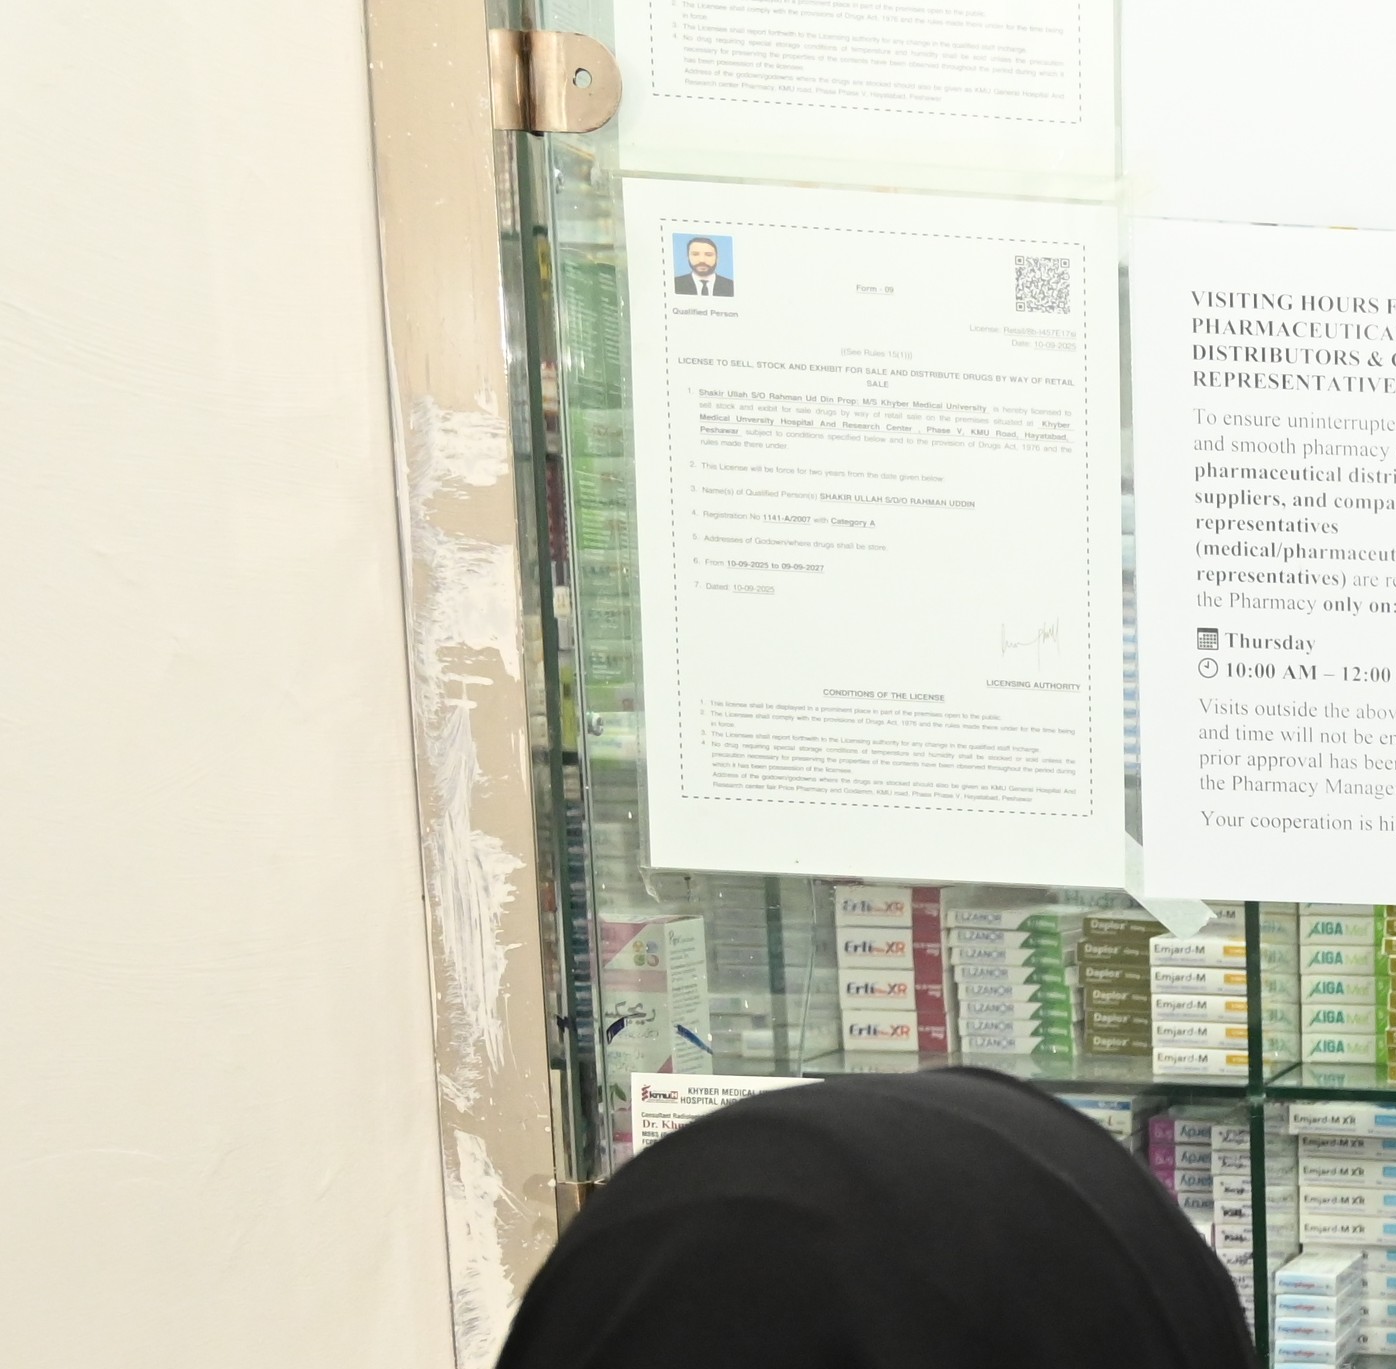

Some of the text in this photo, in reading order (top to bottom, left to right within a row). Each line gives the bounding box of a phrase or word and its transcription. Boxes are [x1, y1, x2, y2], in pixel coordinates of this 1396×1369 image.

[672, 307, 739, 318] Qualified Person
[1190, 289, 1293, 311] VISITING
[1300, 294, 1380, 314] HOURS
[1192, 343, 1361, 366] DISTRIBUTORS
[1366, 350, 1383, 368] &
[677, 356, 1075, 386] LICENSE TO SELL, STOCK AND EXHIBIT FOR SALE AND DISTRIBUTE DRUGS BY WAY OF RETAIL
[866, 379, 889, 388] SALE
[1192, 407, 1218, 426] To
[1222, 413, 1282, 428] ensure
[1192, 434, 1225, 452] and
[1230, 436, 1296, 455] smooth
[1302, 437, 1390, 463] pharmacy
[1194, 461, 1342, 483] pharmaceutical
[1194, 488, 1287, 510] suppliers,
[1291, 491, 1327, 508] and
[1195, 516, 1339, 535] representatives
[1196, 568, 1347, 589] representatives)
[1352, 574, 1379, 588] are
[1196, 590, 1223, 608] the
[1229, 591, 1317, 616] Pharmacy
[1322, 595, 1363, 617] only
[1224, 632, 1316, 654] Thursday
[1226, 661, 1276, 679] 10:00
[1282, 663, 1317, 681] AM
[1342, 665, 1392, 683] 12:00
[823, 688, 875, 698] CONDITIONS
[891, 691, 907, 699] THE
[909, 692, 945, 701] LICENSE
[986, 679, 1081, 691] LICENSING AUTHORITY
[1198, 697, 1249, 716] Visits
[1253, 699, 1318, 718] outside
[1323, 701, 1351, 719] the
[1197, 723, 1230, 741] and
[1235, 723, 1274, 742] time
[1279, 725, 1313, 743] will
[1319, 730, 1347, 745] not
[1352, 727, 1374, 745] be
[1198, 748, 1242, 770] prior
[1246, 751, 1323, 772] approval
[1328, 751, 1358, 770] has
[1199, 773, 1226, 791] the
[1231, 774, 1319, 798] Pharmacy
[1199, 809, 1246, 828] Your
[1249, 813, 1353, 834] cooperation
[1359, 813, 1373, 831] is
[680, 1096, 719, 1106] HOSPITAL
[687, 1087, 720, 1096] KHYBER
[642, 1119, 658, 1129] Dr.
